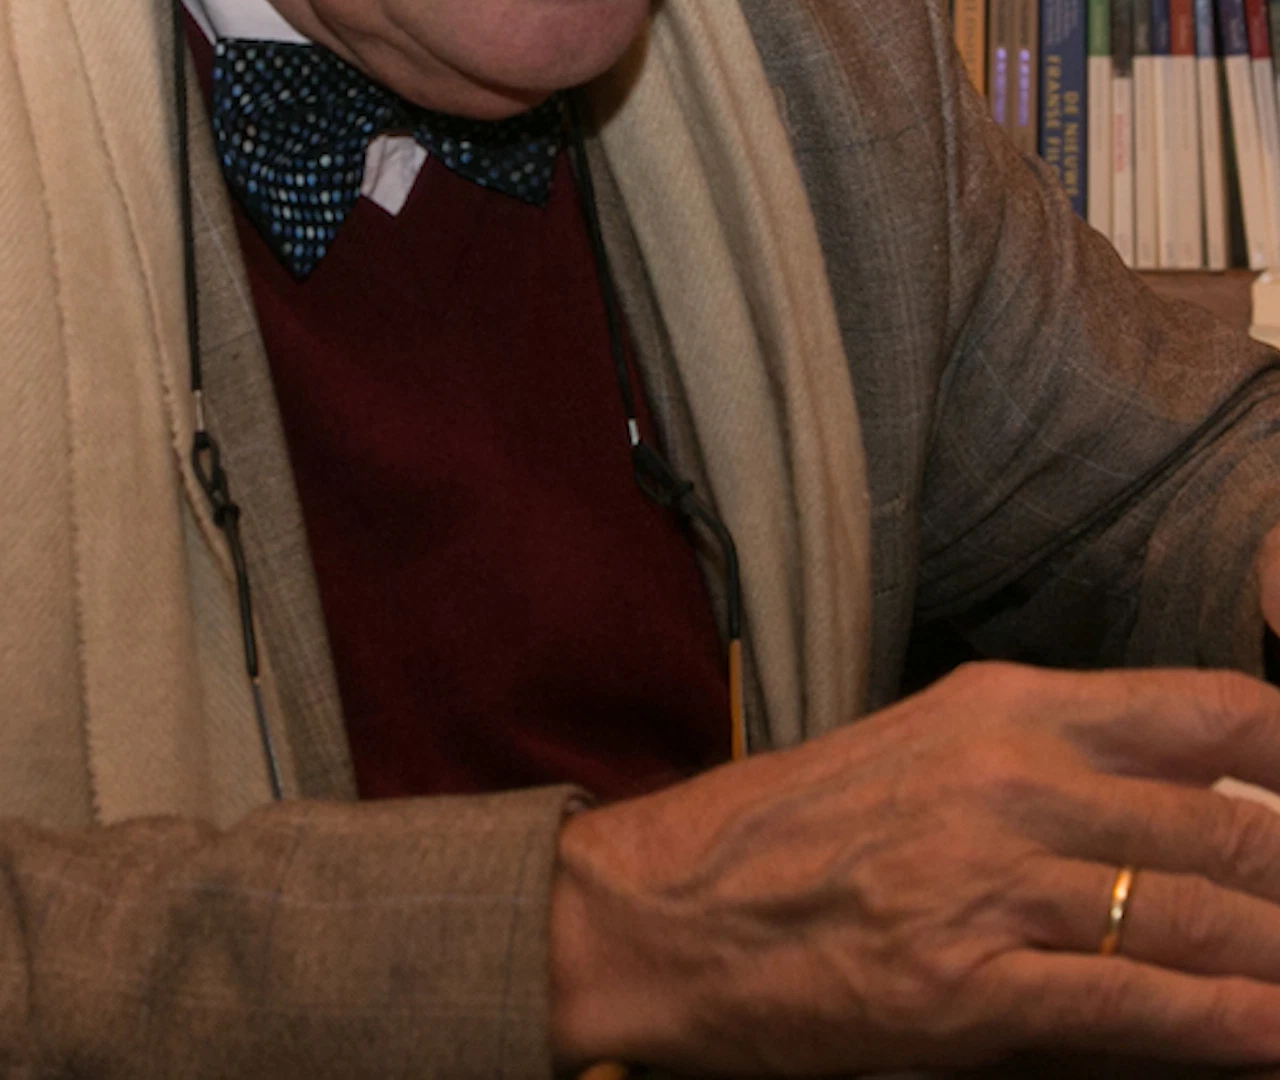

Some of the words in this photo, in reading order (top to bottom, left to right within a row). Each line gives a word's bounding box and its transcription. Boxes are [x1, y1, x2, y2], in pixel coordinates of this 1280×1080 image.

[1046, 54, 1062, 128] FRANSE
[1064, 90, 1080, 115] DE
[1064, 121, 1080, 196] NIEUWE
